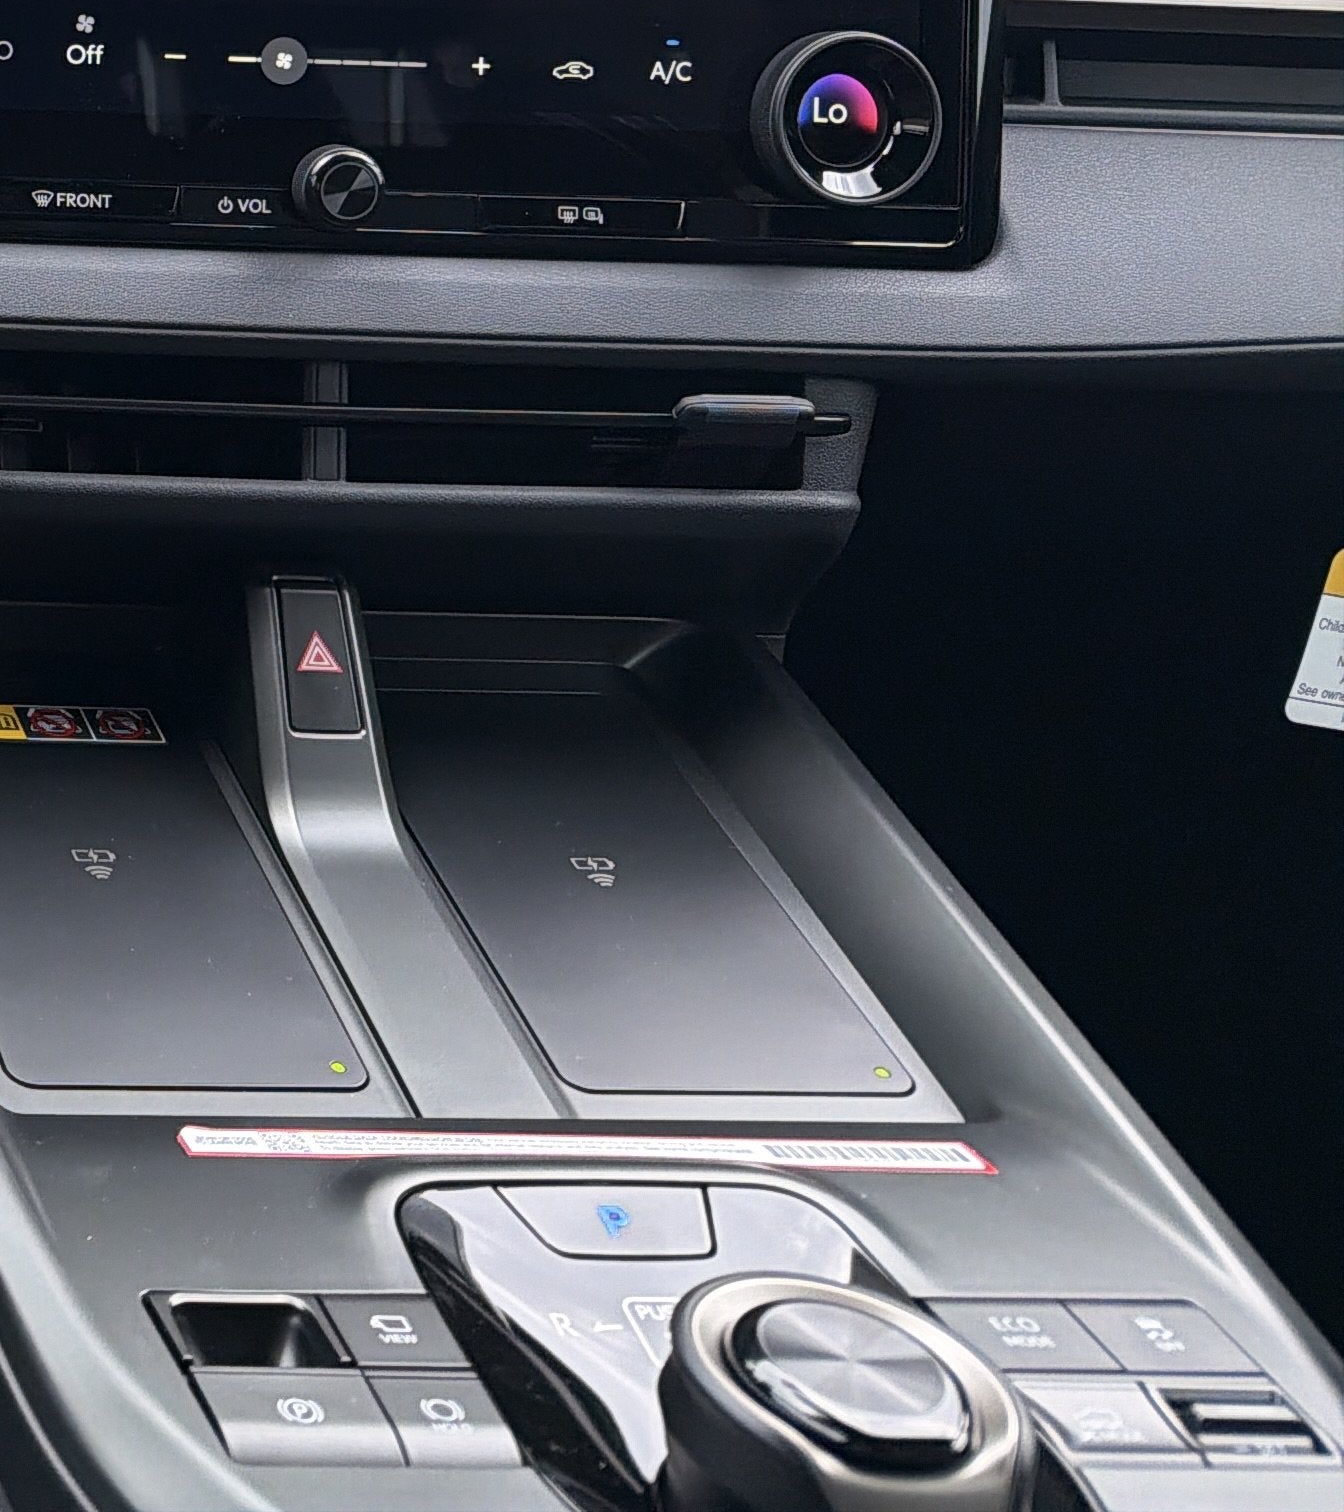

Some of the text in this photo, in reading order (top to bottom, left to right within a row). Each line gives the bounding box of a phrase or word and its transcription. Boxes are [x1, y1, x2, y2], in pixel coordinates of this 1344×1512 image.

[65, 43, 105, 66] Off
[649, 59, 693, 85] A/C
[812, 98, 848, 125] Lo
[56, 192, 113, 210] FRONT
[237, 198, 272, 215] VOL
[1297, 683, 1319, 698] See
[596, 1204, 629, 1239] P
[548, 1312, 581, 1338] R
